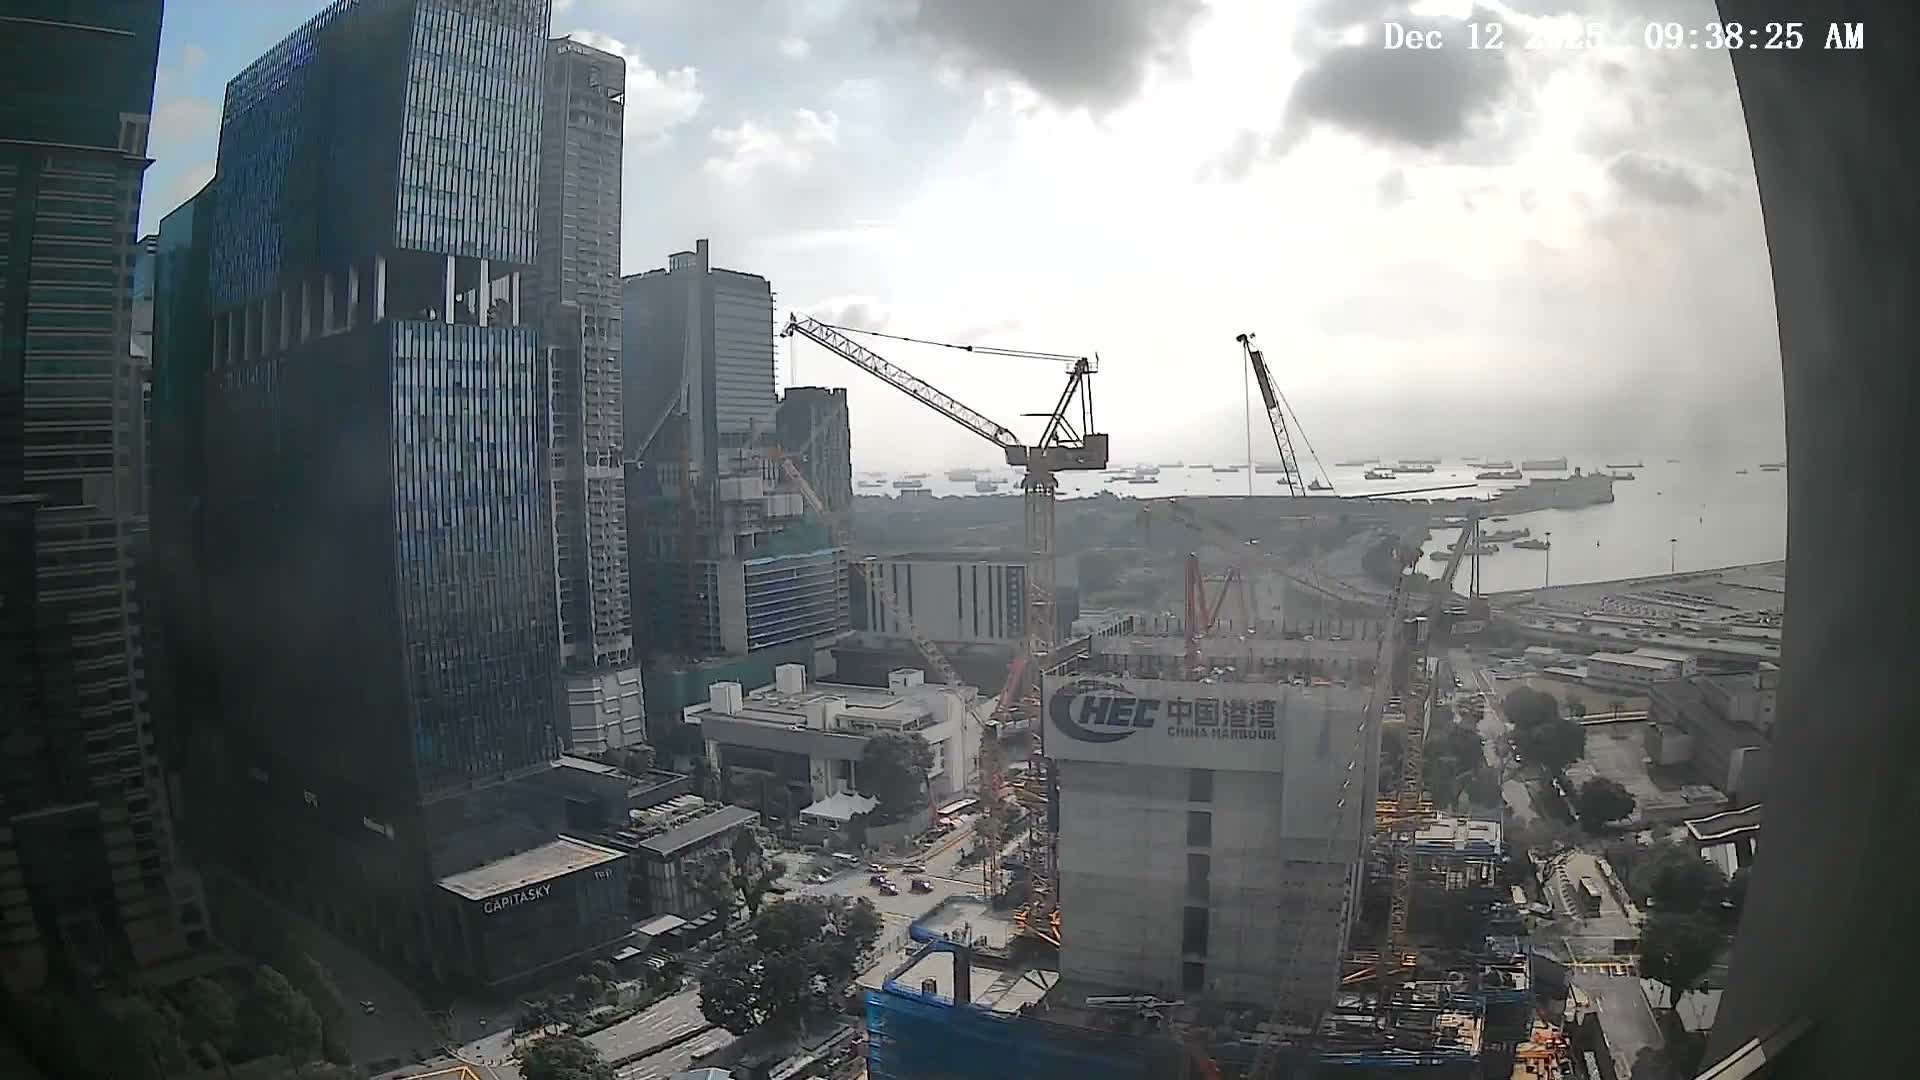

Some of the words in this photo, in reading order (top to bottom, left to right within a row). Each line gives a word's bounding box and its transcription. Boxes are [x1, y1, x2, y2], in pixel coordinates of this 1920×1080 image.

[1167, 696, 1277, 728] 中国港湾
[1167, 726, 1208, 738] CHINA
[1212, 727, 1276, 740] HARBOUR
[483, 883, 551, 914] CAPITASKY
